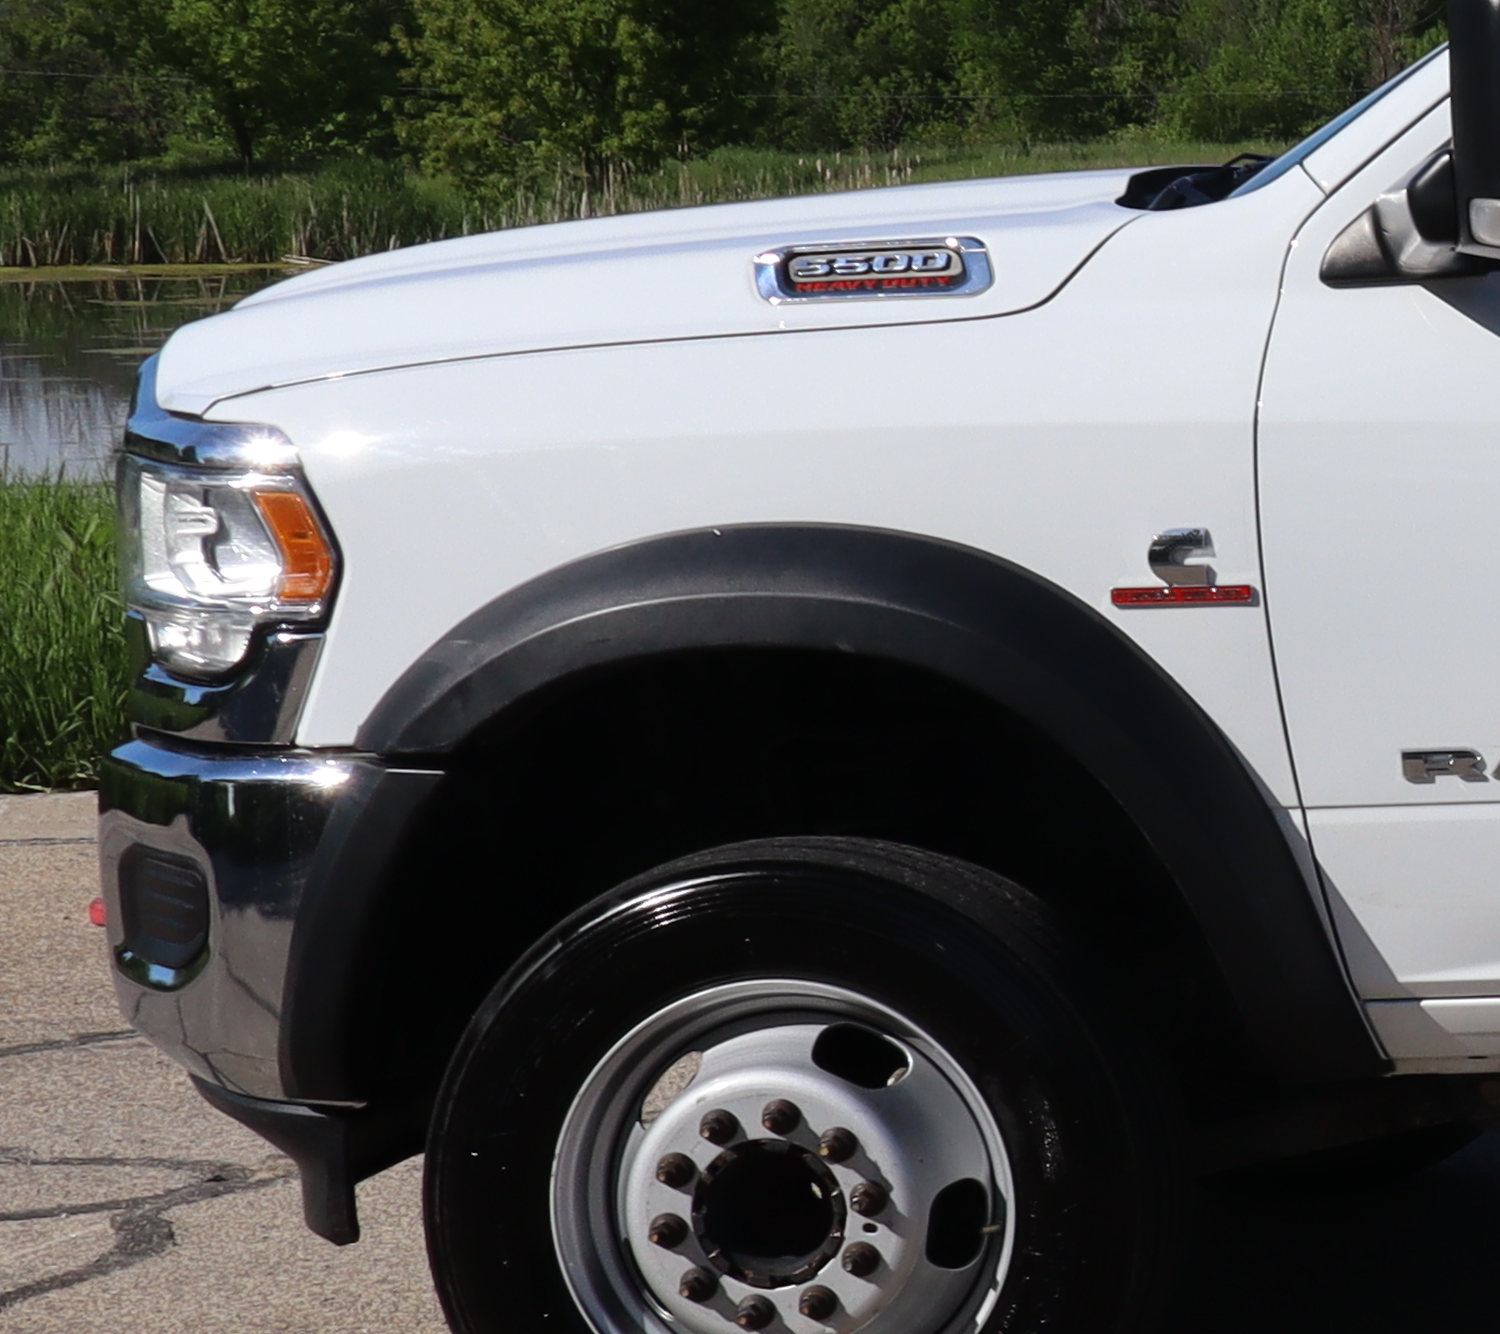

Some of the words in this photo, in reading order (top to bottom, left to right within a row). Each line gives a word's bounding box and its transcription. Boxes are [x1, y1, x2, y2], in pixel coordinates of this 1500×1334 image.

[796, 252, 951, 276] 5500
[795, 279, 878, 293] HEAVY
[883, 276, 952, 289] DUTY
